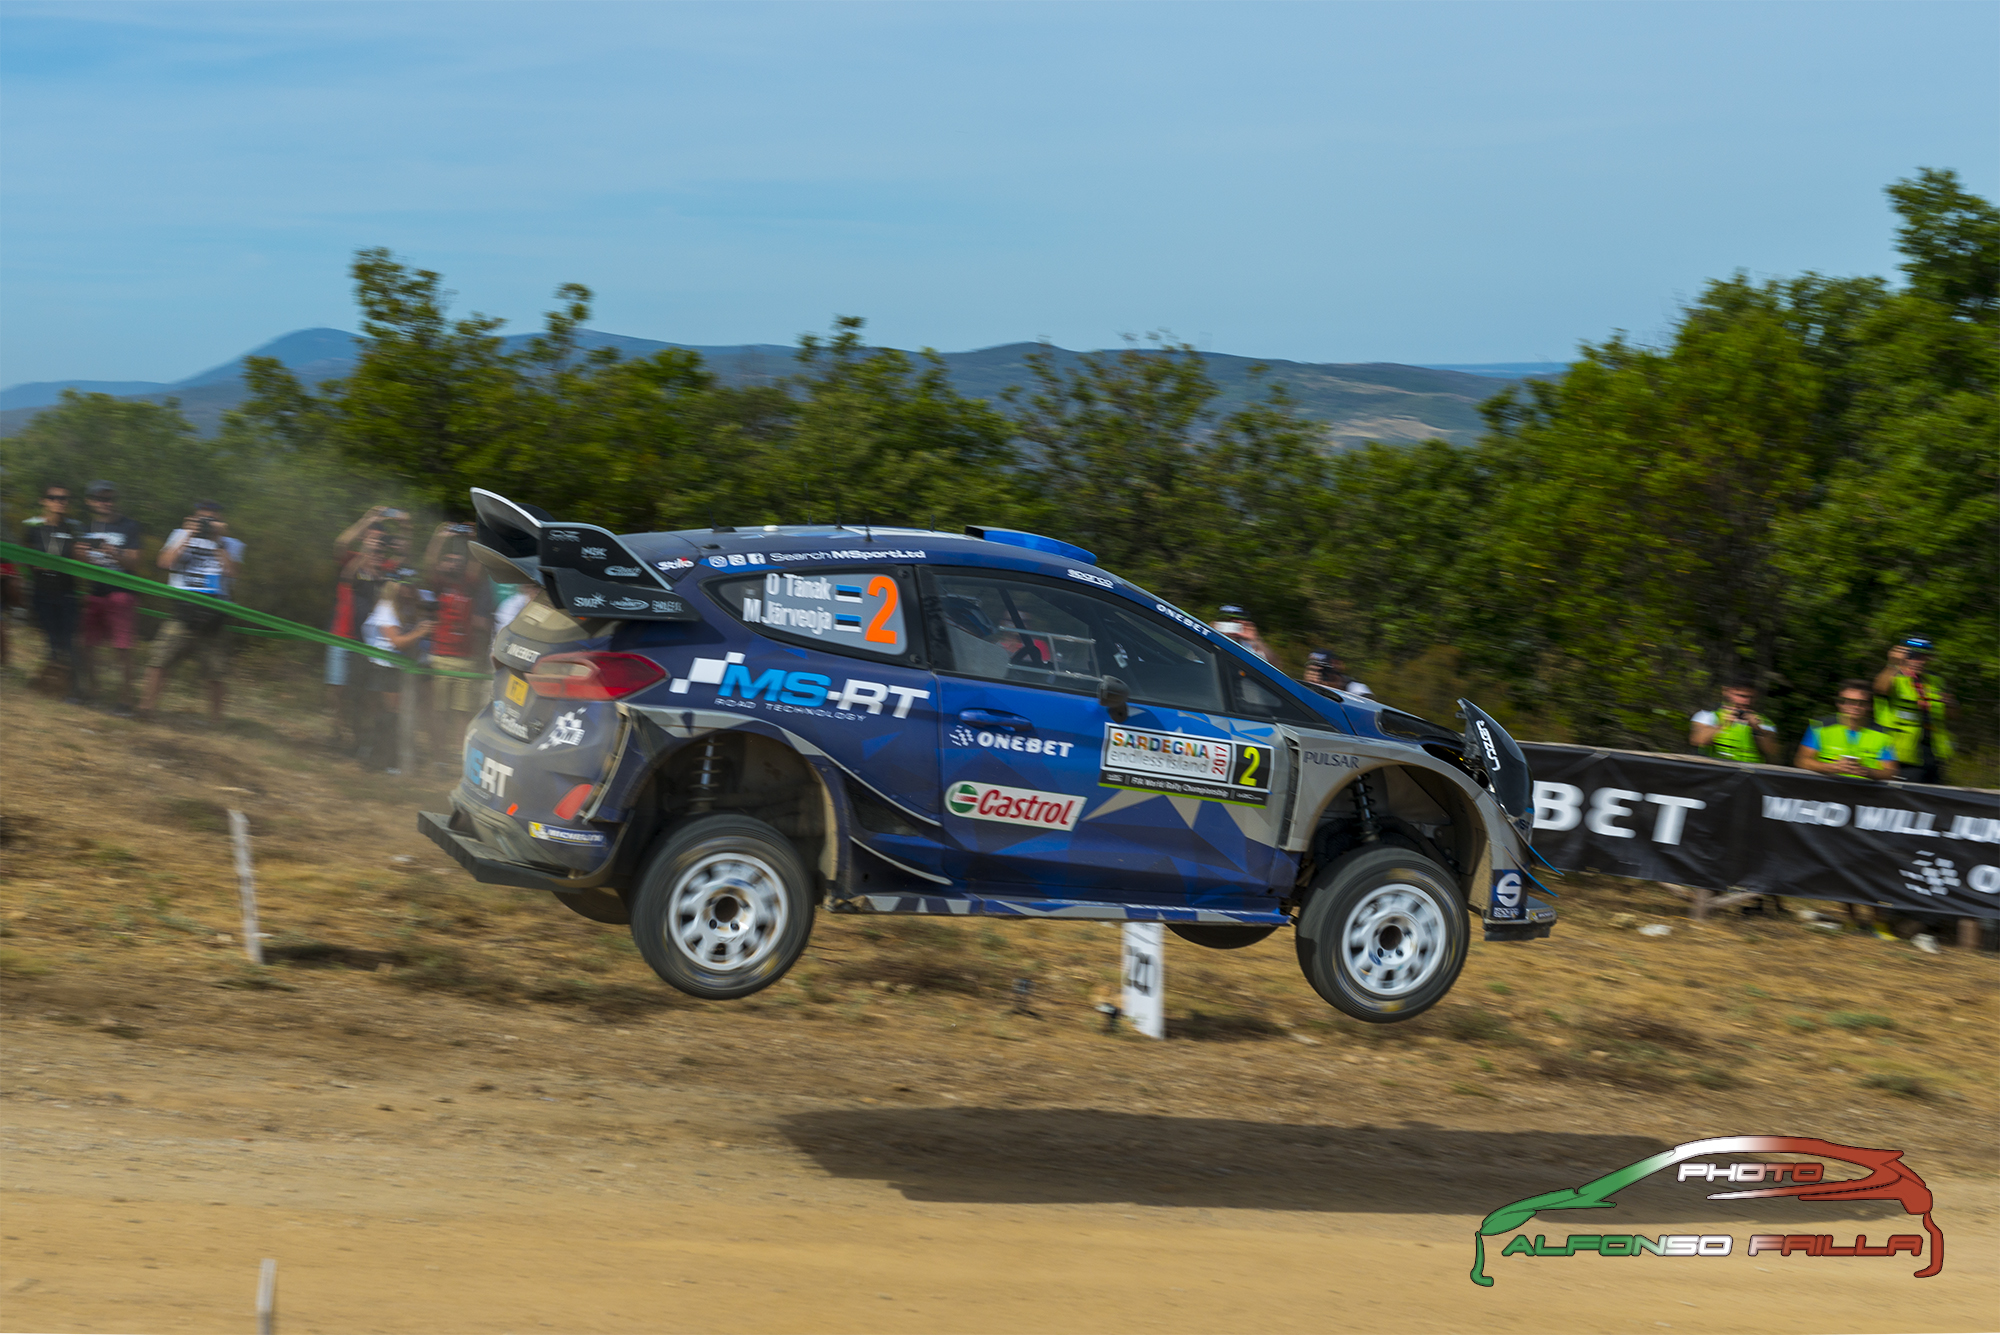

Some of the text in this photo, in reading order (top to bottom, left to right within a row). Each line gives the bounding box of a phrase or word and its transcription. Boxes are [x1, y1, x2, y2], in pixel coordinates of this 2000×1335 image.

[766, 573, 780, 596] O
[742, 597, 762, 624] M
[865, 575, 899, 645] 2
[1156, 603, 1211, 636] ONEBET
[717, 664, 931, 719] MS-RT
[714, 697, 867, 722] ROAD TECHNOLOGY
[976, 730, 1074, 758] ONEBET
[1111, 732, 1210, 760] SARDEGNA
[1109, 750, 1209, 774] endless island
[1212, 745, 1228, 776] 2017
[1239, 746, 1261, 787] 2
[1303, 751, 1360, 769] PULSAR
[977, 788, 1075, 826] Castrol
[1854, 804, 1941, 838] WILL
